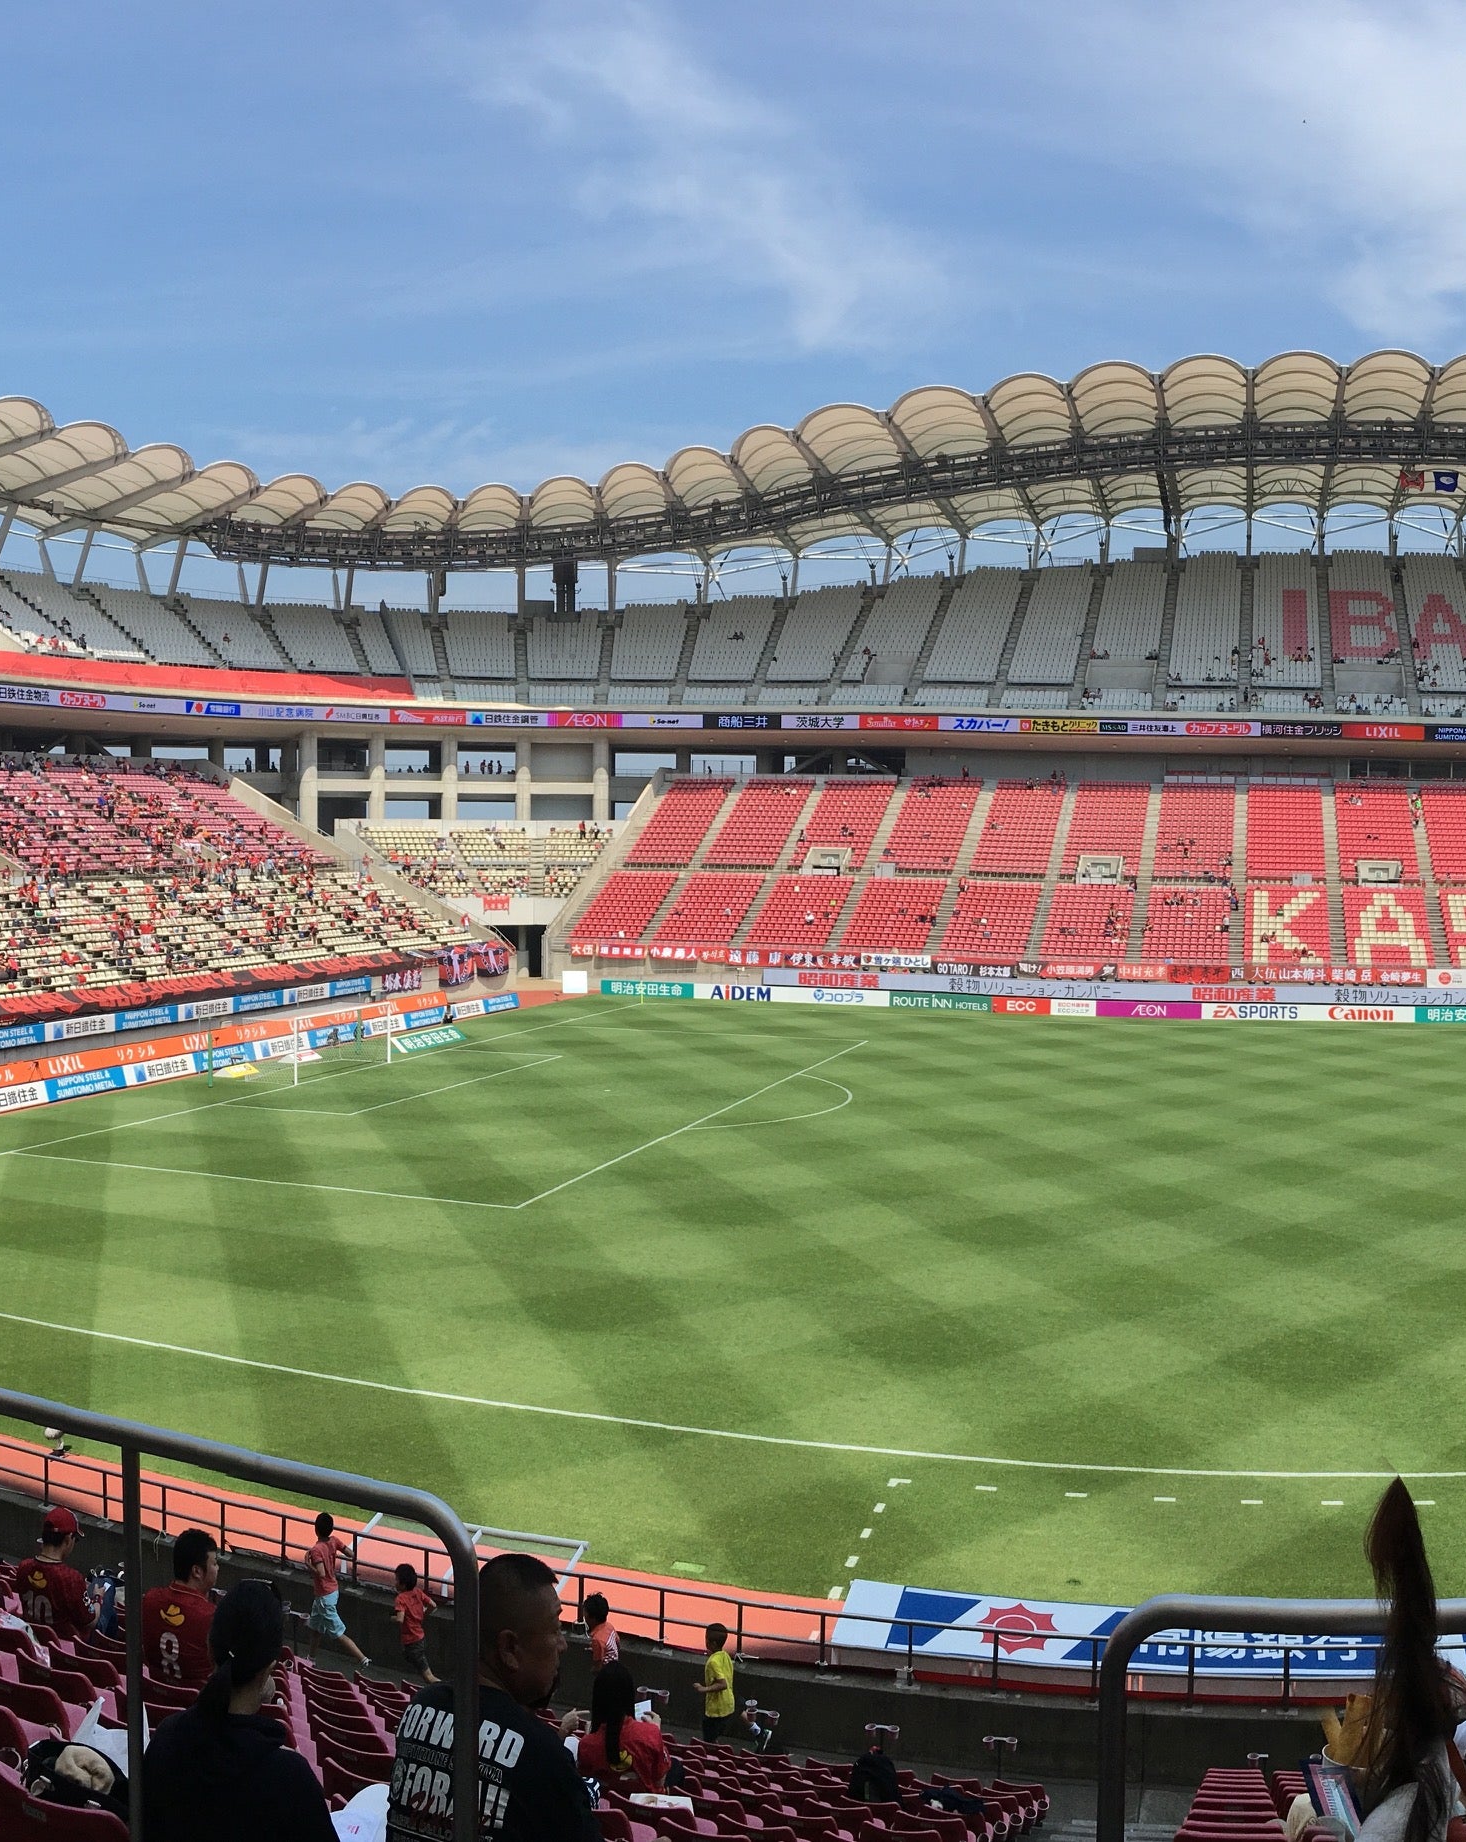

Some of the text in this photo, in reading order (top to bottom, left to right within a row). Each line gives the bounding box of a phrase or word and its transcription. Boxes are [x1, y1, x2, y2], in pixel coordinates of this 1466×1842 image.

[718, 716, 768, 728] 商船三井
[796, 716, 845, 729] 茨城大学
[1366, 726, 1401, 738] LIXIL
[937, 963, 948, 974] GO
[1231, 966, 1244, 979] 西
[611, 982, 683, 997] 明治安田生命
[798, 972, 879, 988] 昭和産業
[1192, 986, 1276, 1002] 昭和産業
[824, 992, 864, 1003] コロプラ
[893, 996, 988, 1011] ROUTE HOTELS
[1006, 1000, 1036, 1011] ECC
[1238, 1005, 1298, 1019] SPORTS
[1328, 1006, 1394, 1021] Canon
[401, 1028, 462, 1050] 明治安田生命
[116, 1045, 156, 1062] リクシル
[47, 1055, 85, 1075] LIXIL
[396, 1704, 525, 1768] FORWRD
